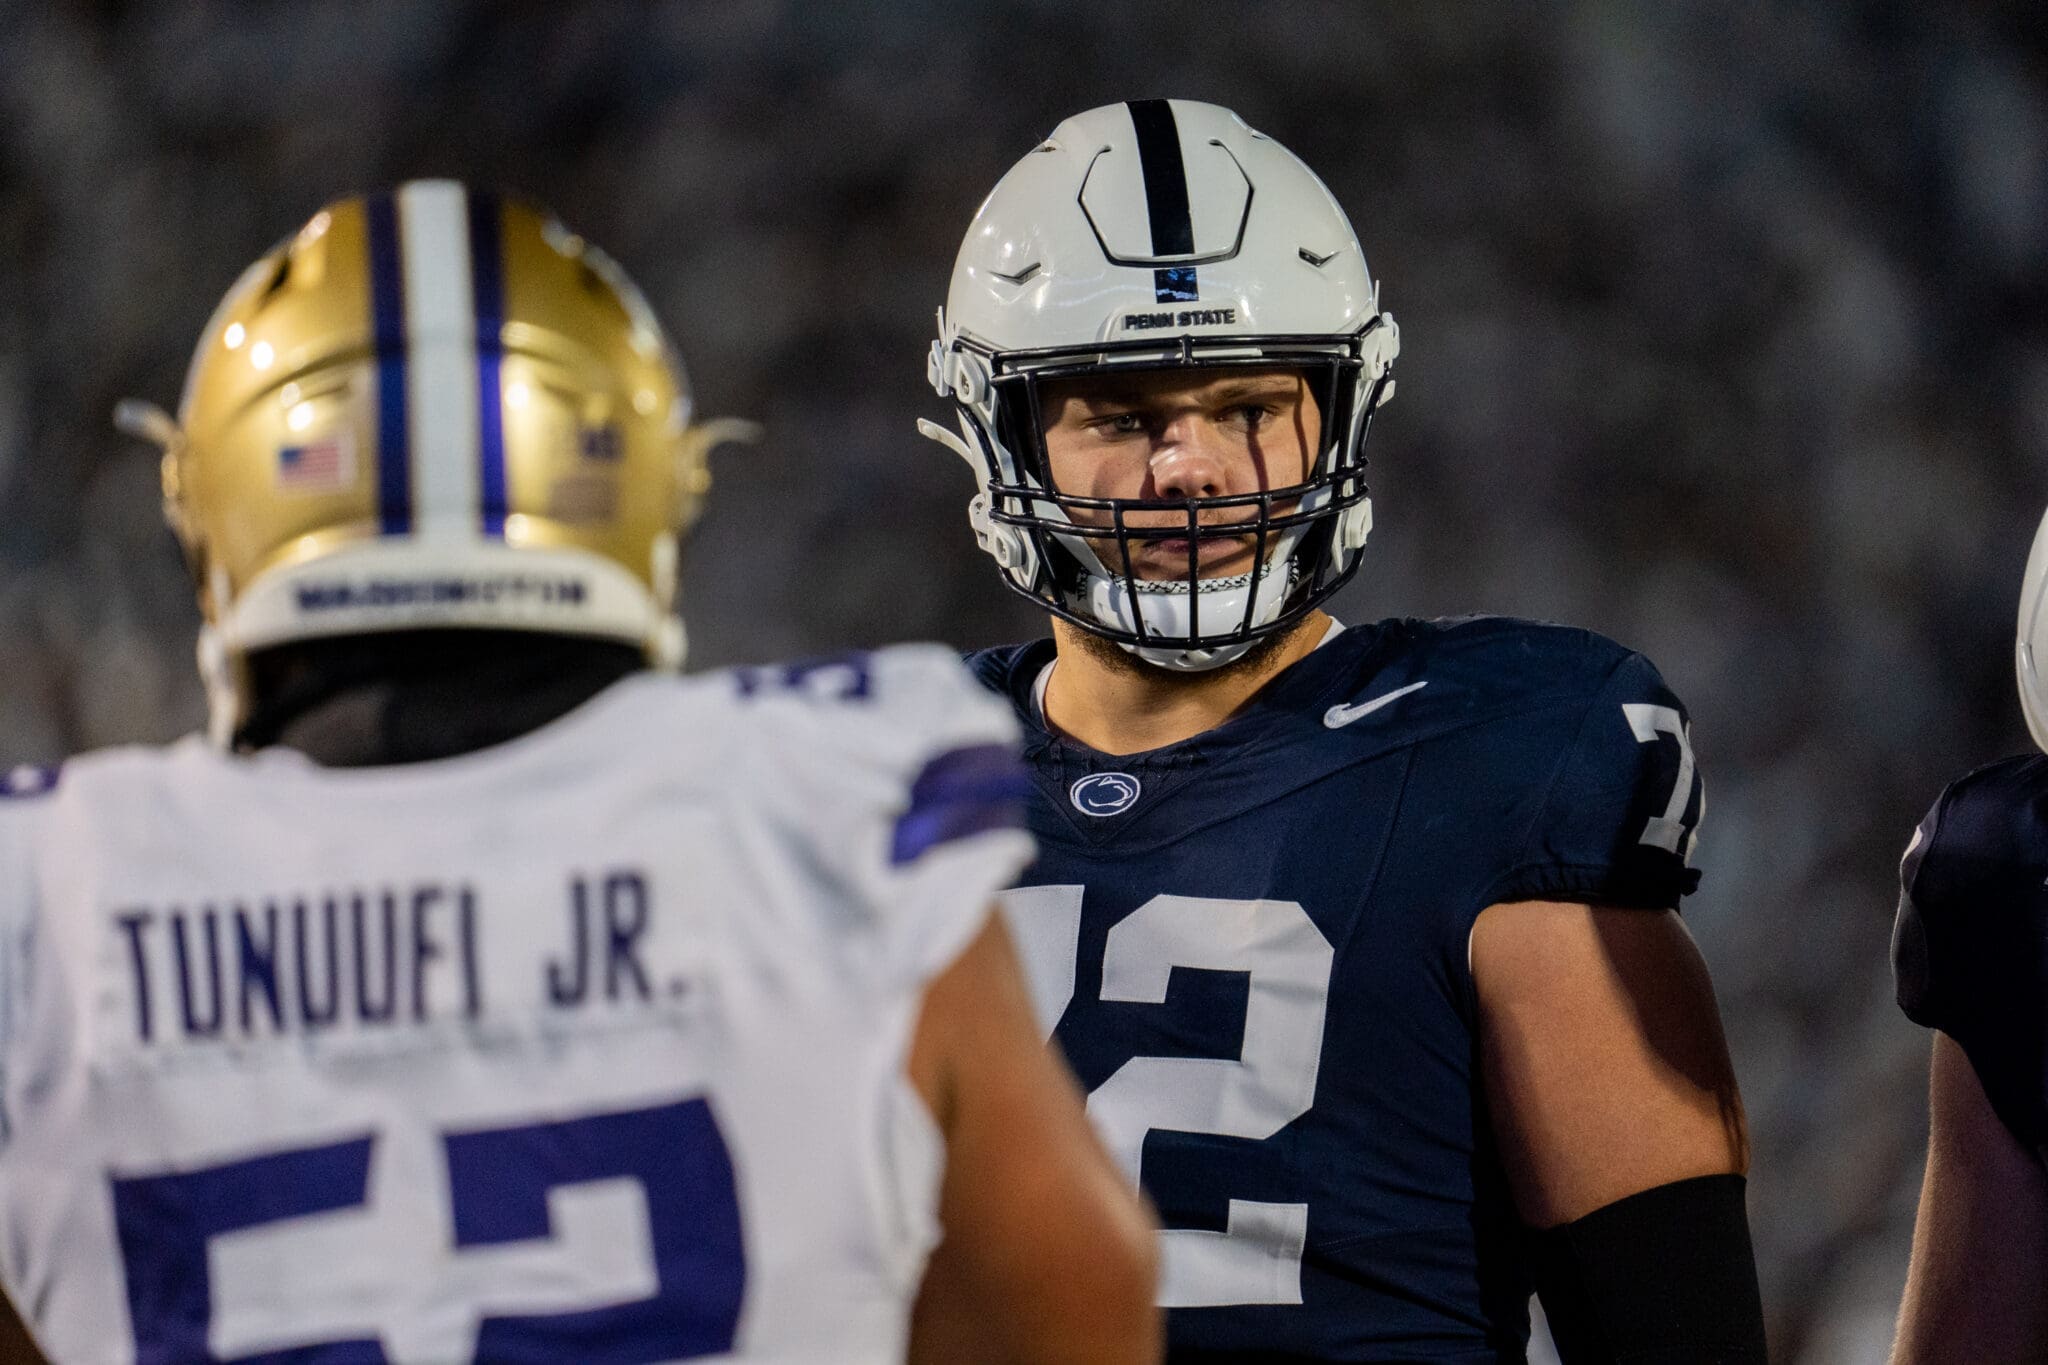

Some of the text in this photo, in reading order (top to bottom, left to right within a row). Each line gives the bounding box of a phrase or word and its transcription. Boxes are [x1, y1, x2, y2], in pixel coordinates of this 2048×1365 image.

[1122, 308, 1236, 330] PENN STATE
[1622, 703, 1706, 868] 7
[115, 867, 691, 1043] TUNUUFI JR.
